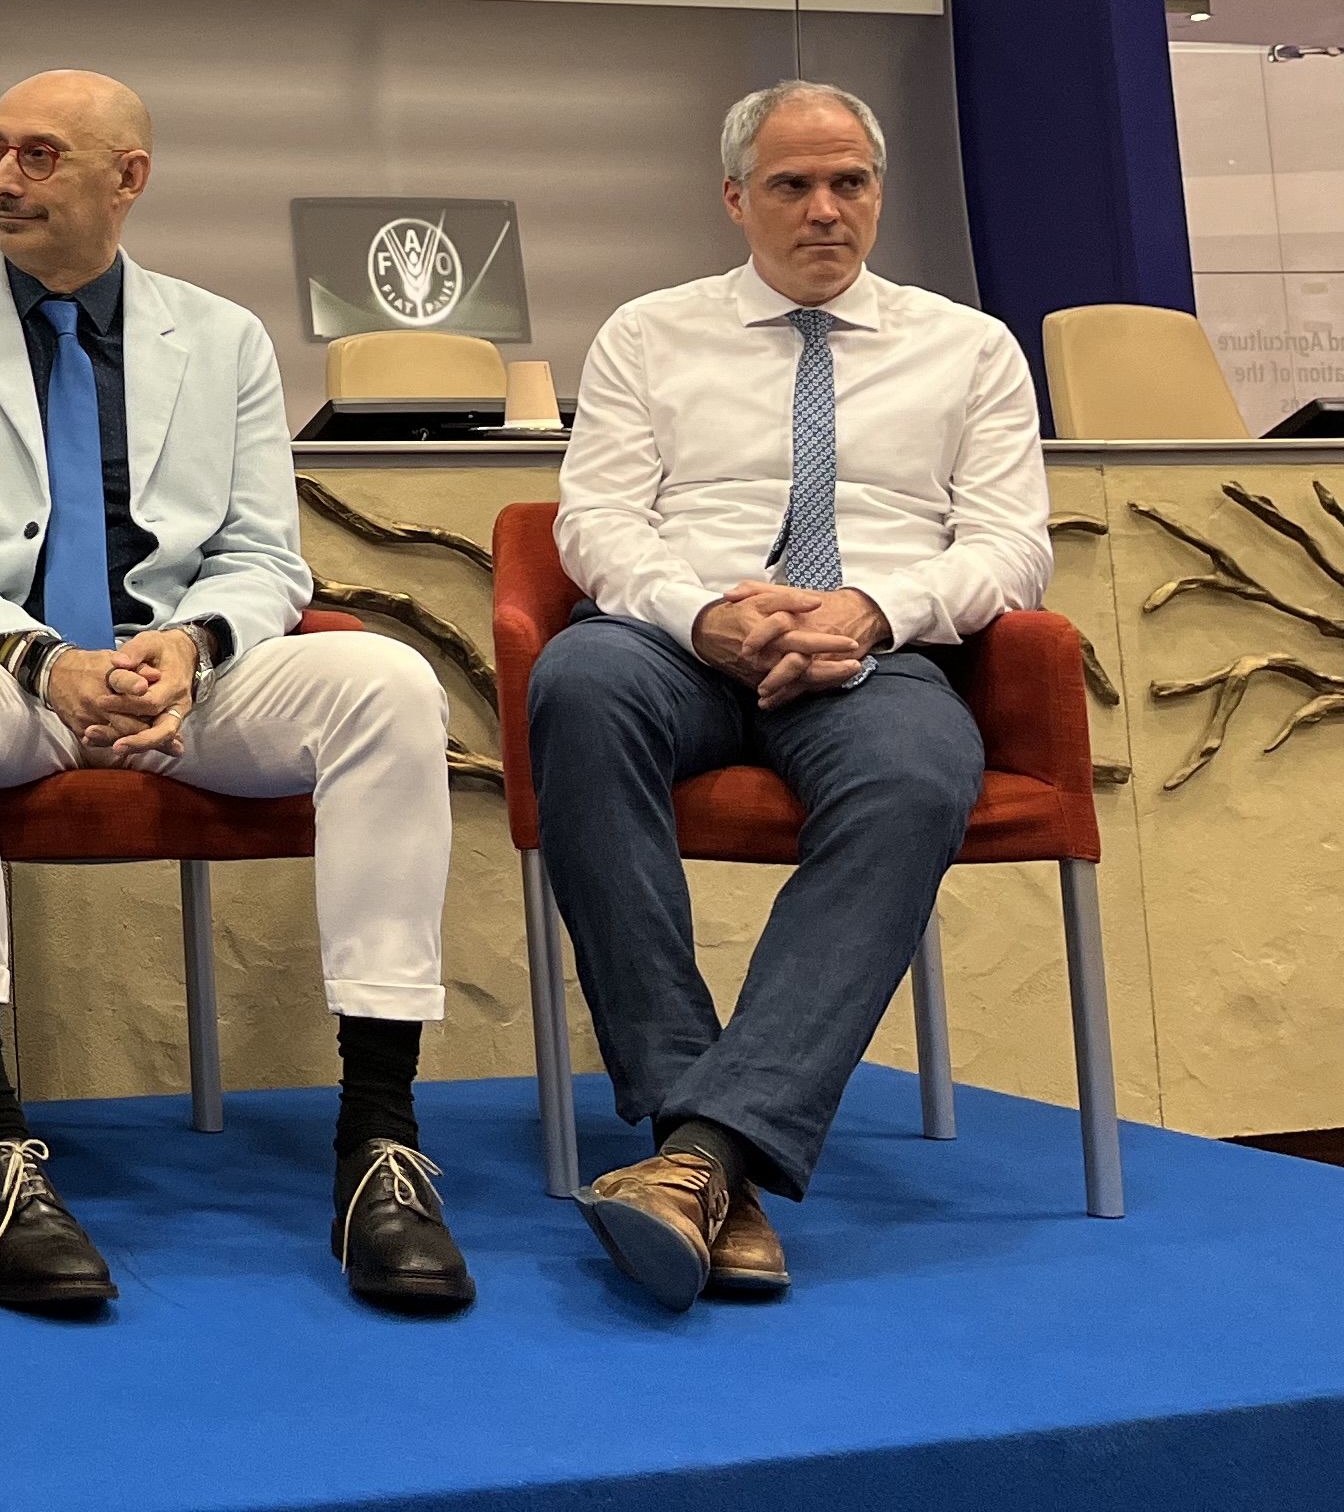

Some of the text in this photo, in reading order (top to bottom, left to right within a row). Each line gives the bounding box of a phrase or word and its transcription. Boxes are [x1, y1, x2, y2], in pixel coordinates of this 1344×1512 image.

[377, 229, 453, 276] FAO
[380, 279, 454, 314] FIAT PANIS
